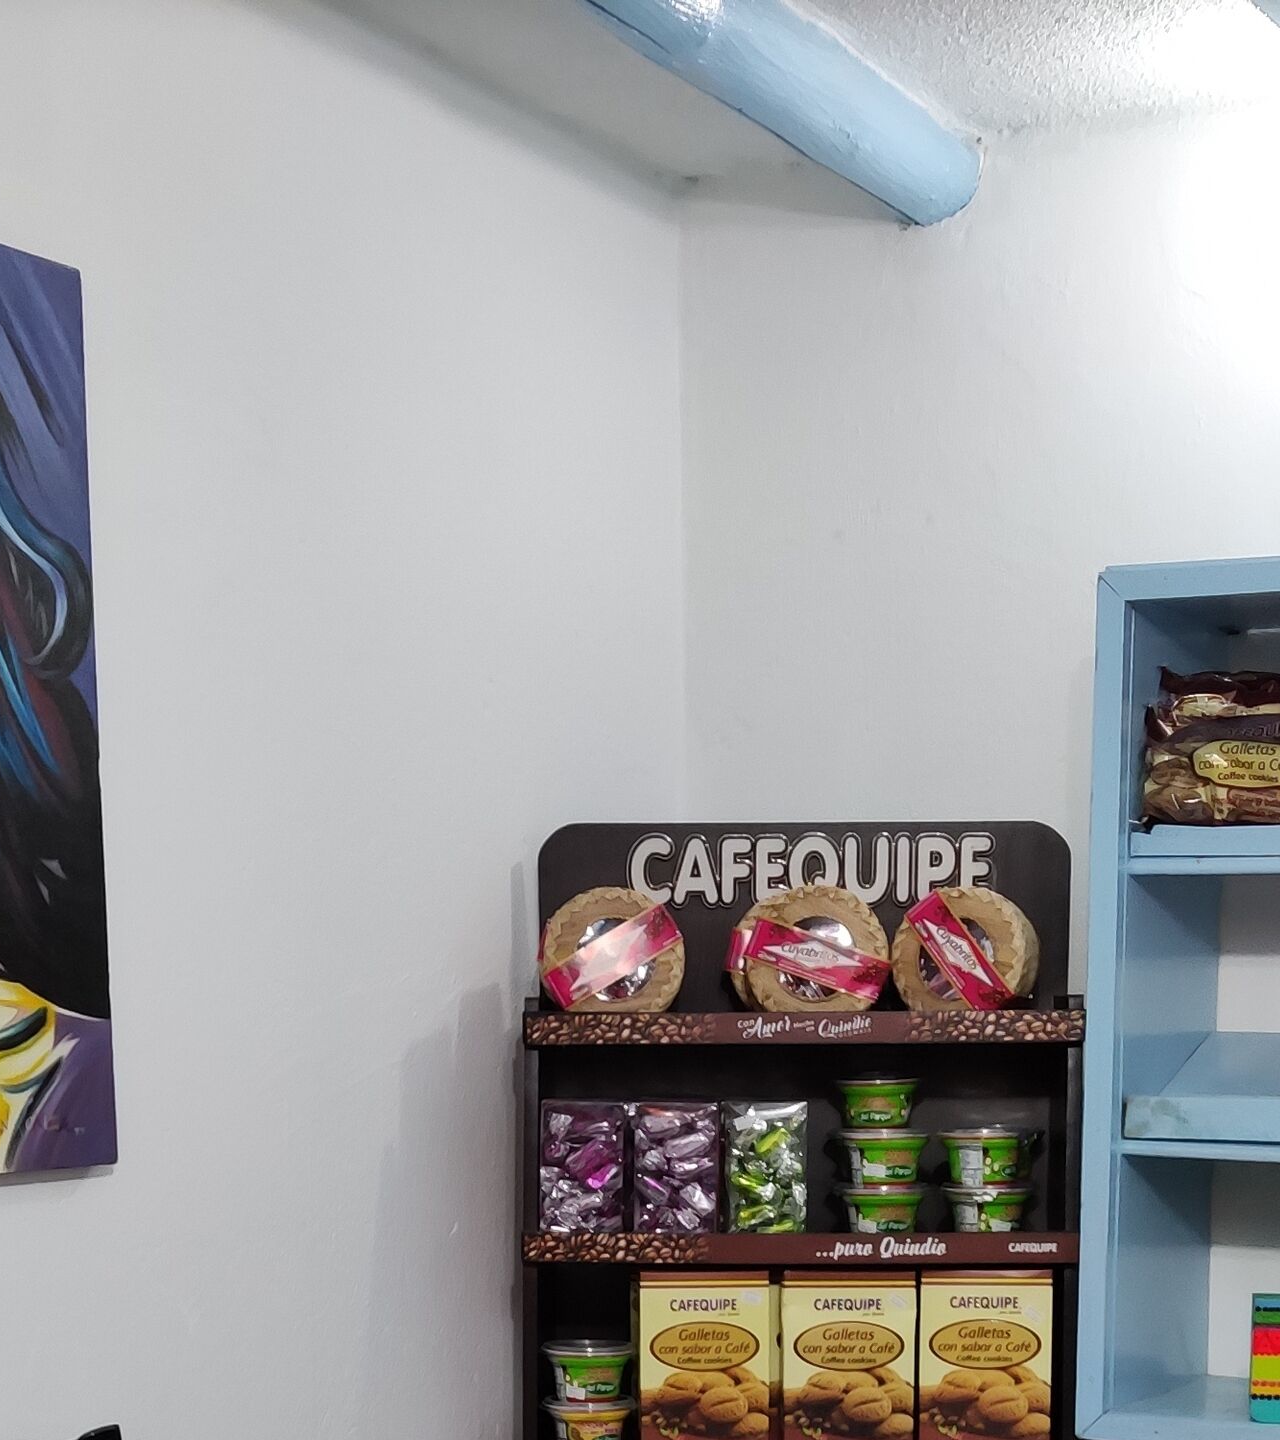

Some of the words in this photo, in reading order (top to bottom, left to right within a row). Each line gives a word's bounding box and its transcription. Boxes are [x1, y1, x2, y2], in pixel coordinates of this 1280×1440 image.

[1220, 741, 1276, 756] Galletas
[1217, 771, 1247, 781] Coffee
[629, 834, 995, 906] CAFEQUIPE
[1008, 1242, 1058, 1253] CAFEQUIPE
[670, 1299, 738, 1312] CAFEQUIPE
[813, 1298, 882, 1311] CAFEQUIPE
[949, 1296, 1018, 1309] CAFEQUIPE
[678, 1328, 730, 1341] Galletas
[822, 1328, 875, 1341] Galletas
[958, 1326, 1011, 1339] Galletas
[659, 1345, 679, 1354] con
[681, 1343, 712, 1354] sabor
[714, 1345, 722, 1354] a
[724, 1341, 751, 1354] Café
[802, 1345, 822, 1354] con
[825, 1343, 856, 1354] sabor
[858, 1345, 866, 1354] a
[869, 1341, 895, 1354] Café
[938, 1343, 958, 1353] con
[961, 1341, 992, 1353] sabor
[995, 1343, 1002, 1352] a
[1005, 1341, 1031, 1353] Café
